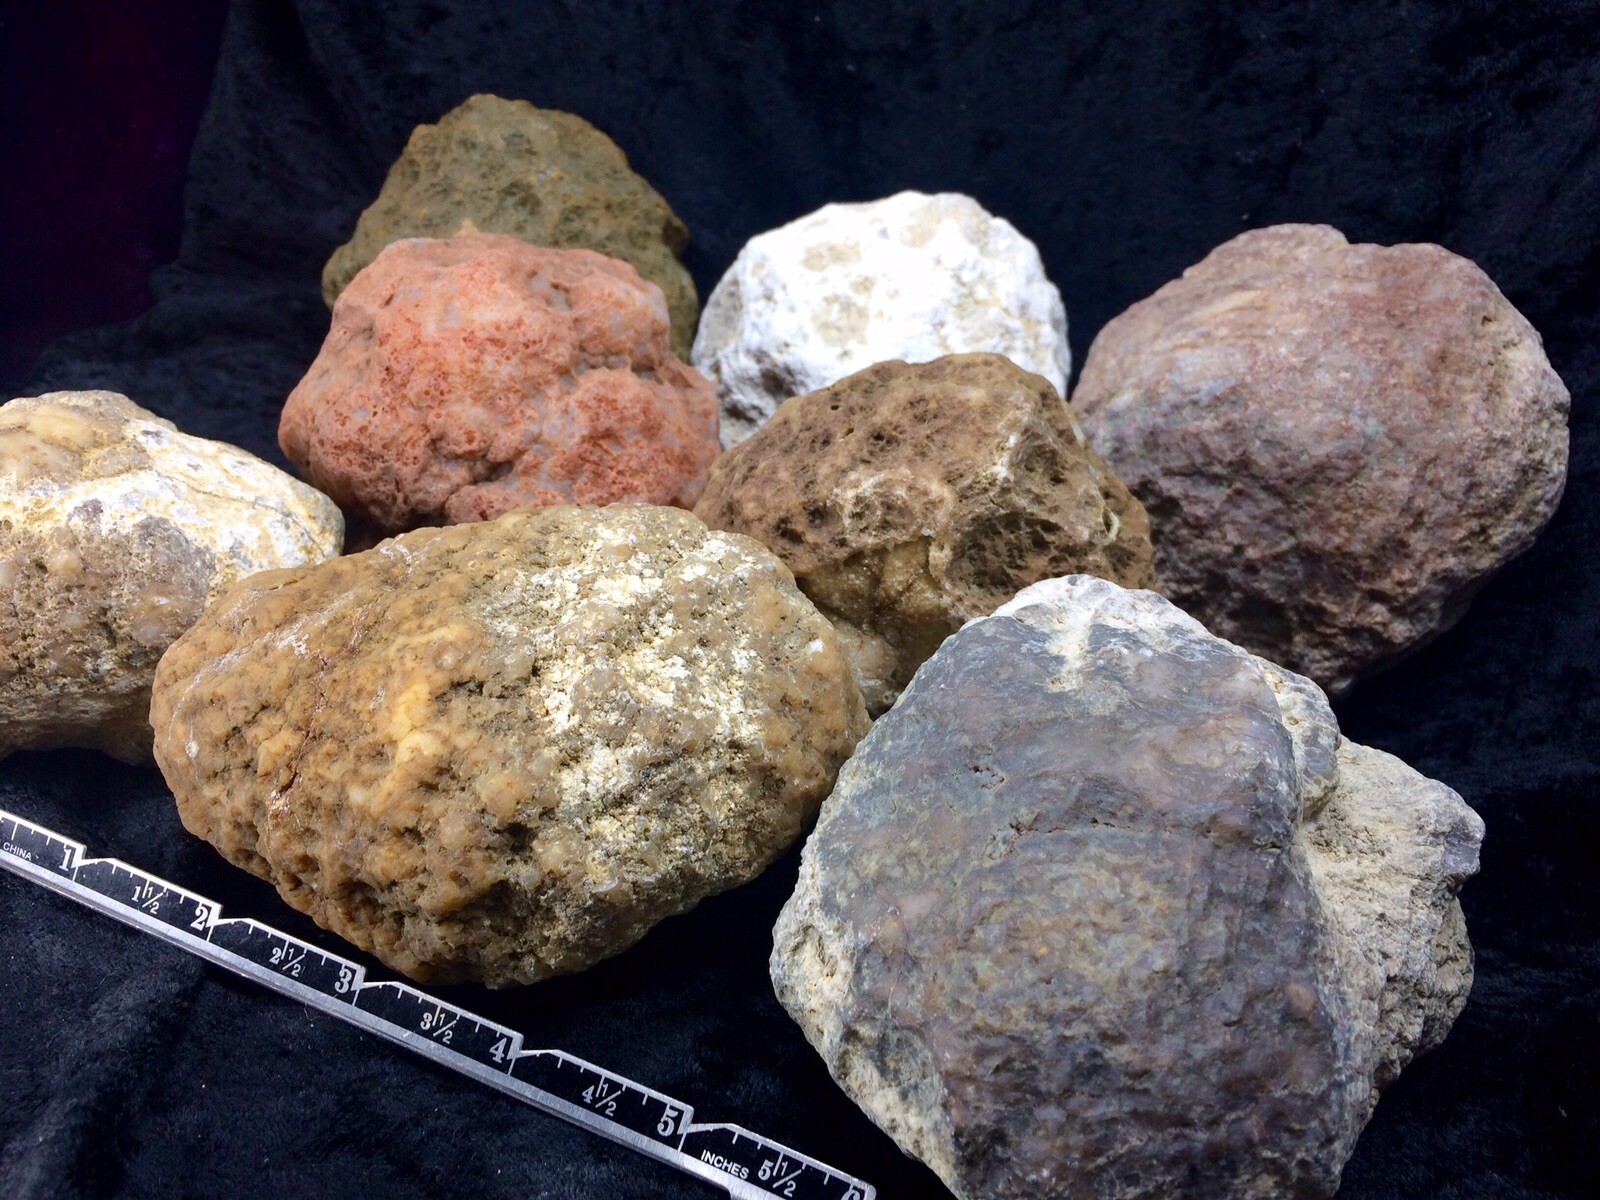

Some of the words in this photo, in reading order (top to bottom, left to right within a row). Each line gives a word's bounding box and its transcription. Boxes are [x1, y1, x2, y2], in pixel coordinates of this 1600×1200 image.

[3, 842, 32, 861] CHINA
[59, 848, 72, 871] 1
[190, 905, 209, 931] 2
[334, 967, 352, 994] 3
[489, 1037, 507, 1064] 4
[657, 1108, 679, 1137] 5
[700, 1149, 749, 1180] INCHES
